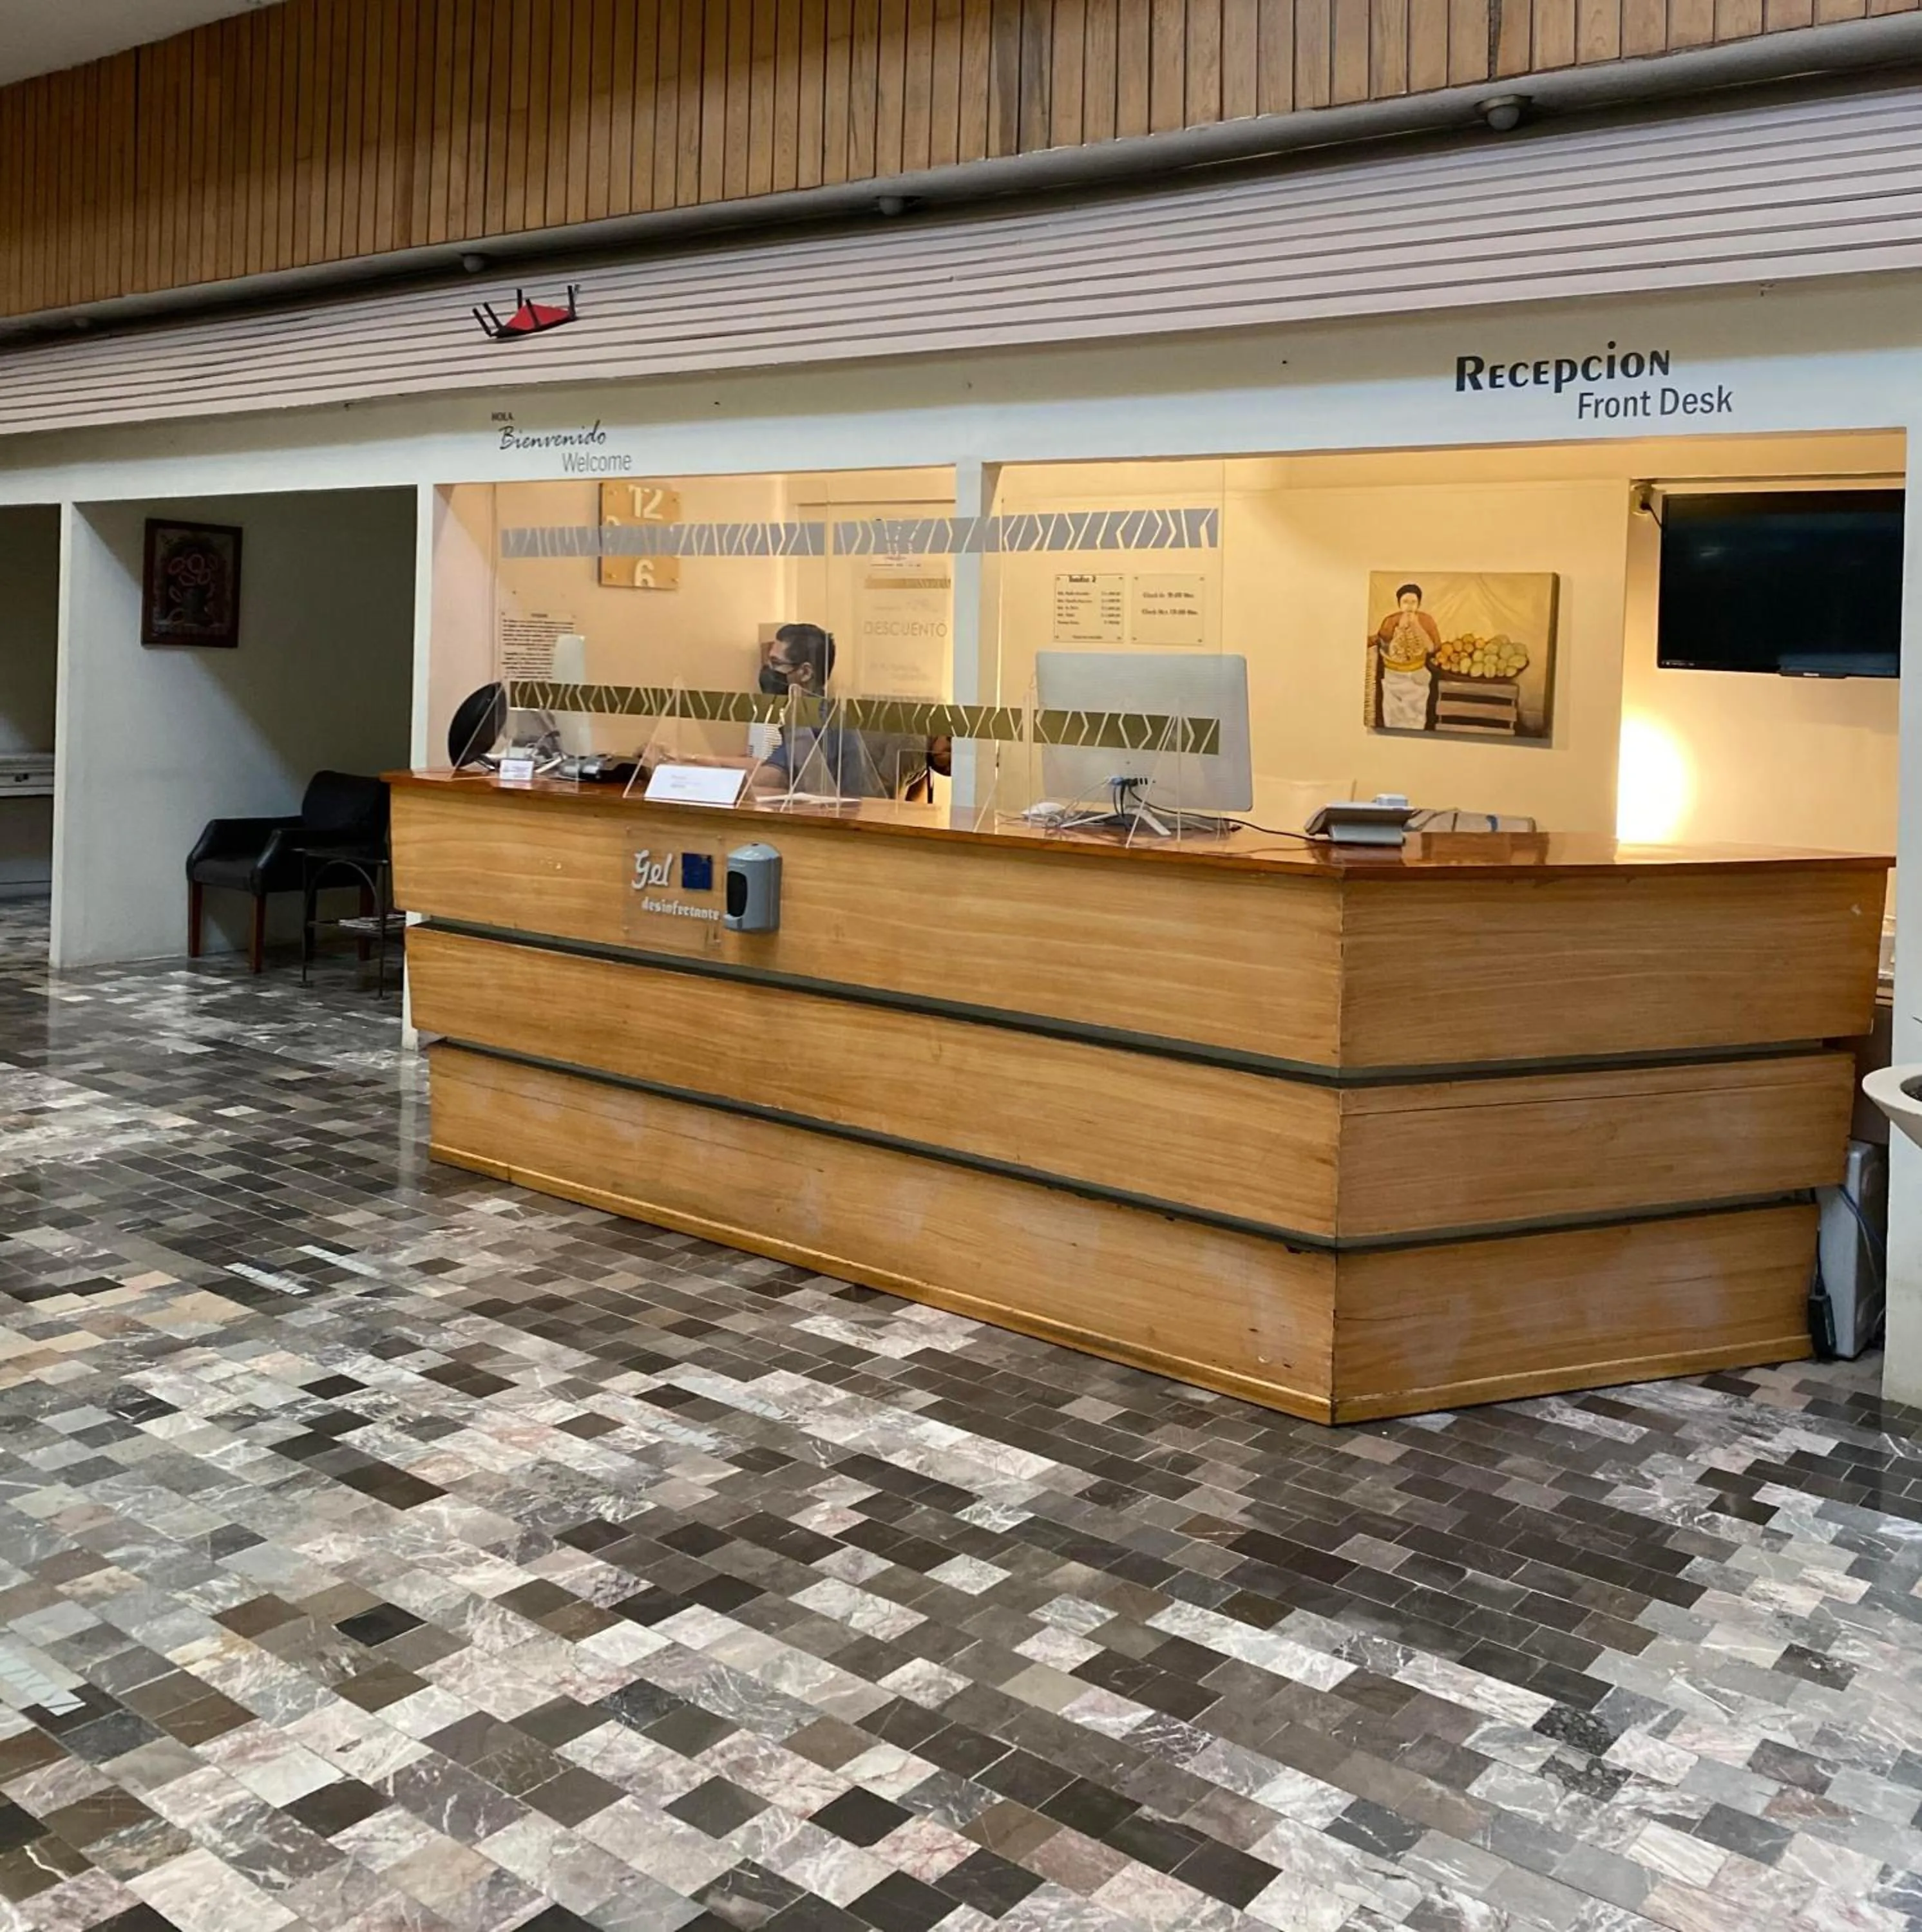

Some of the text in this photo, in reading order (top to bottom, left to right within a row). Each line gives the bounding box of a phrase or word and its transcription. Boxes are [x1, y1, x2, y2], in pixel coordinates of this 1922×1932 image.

[1577, 385, 1735, 419] Front Desk
[499, 419, 607, 450] Bienvenido
[562, 452, 632, 473] Welcome
[627, 484, 663, 520] 12
[634, 558, 656, 587] 6
[864, 621, 948, 638] DESCUENTO
[631, 849, 673, 890] Gel
